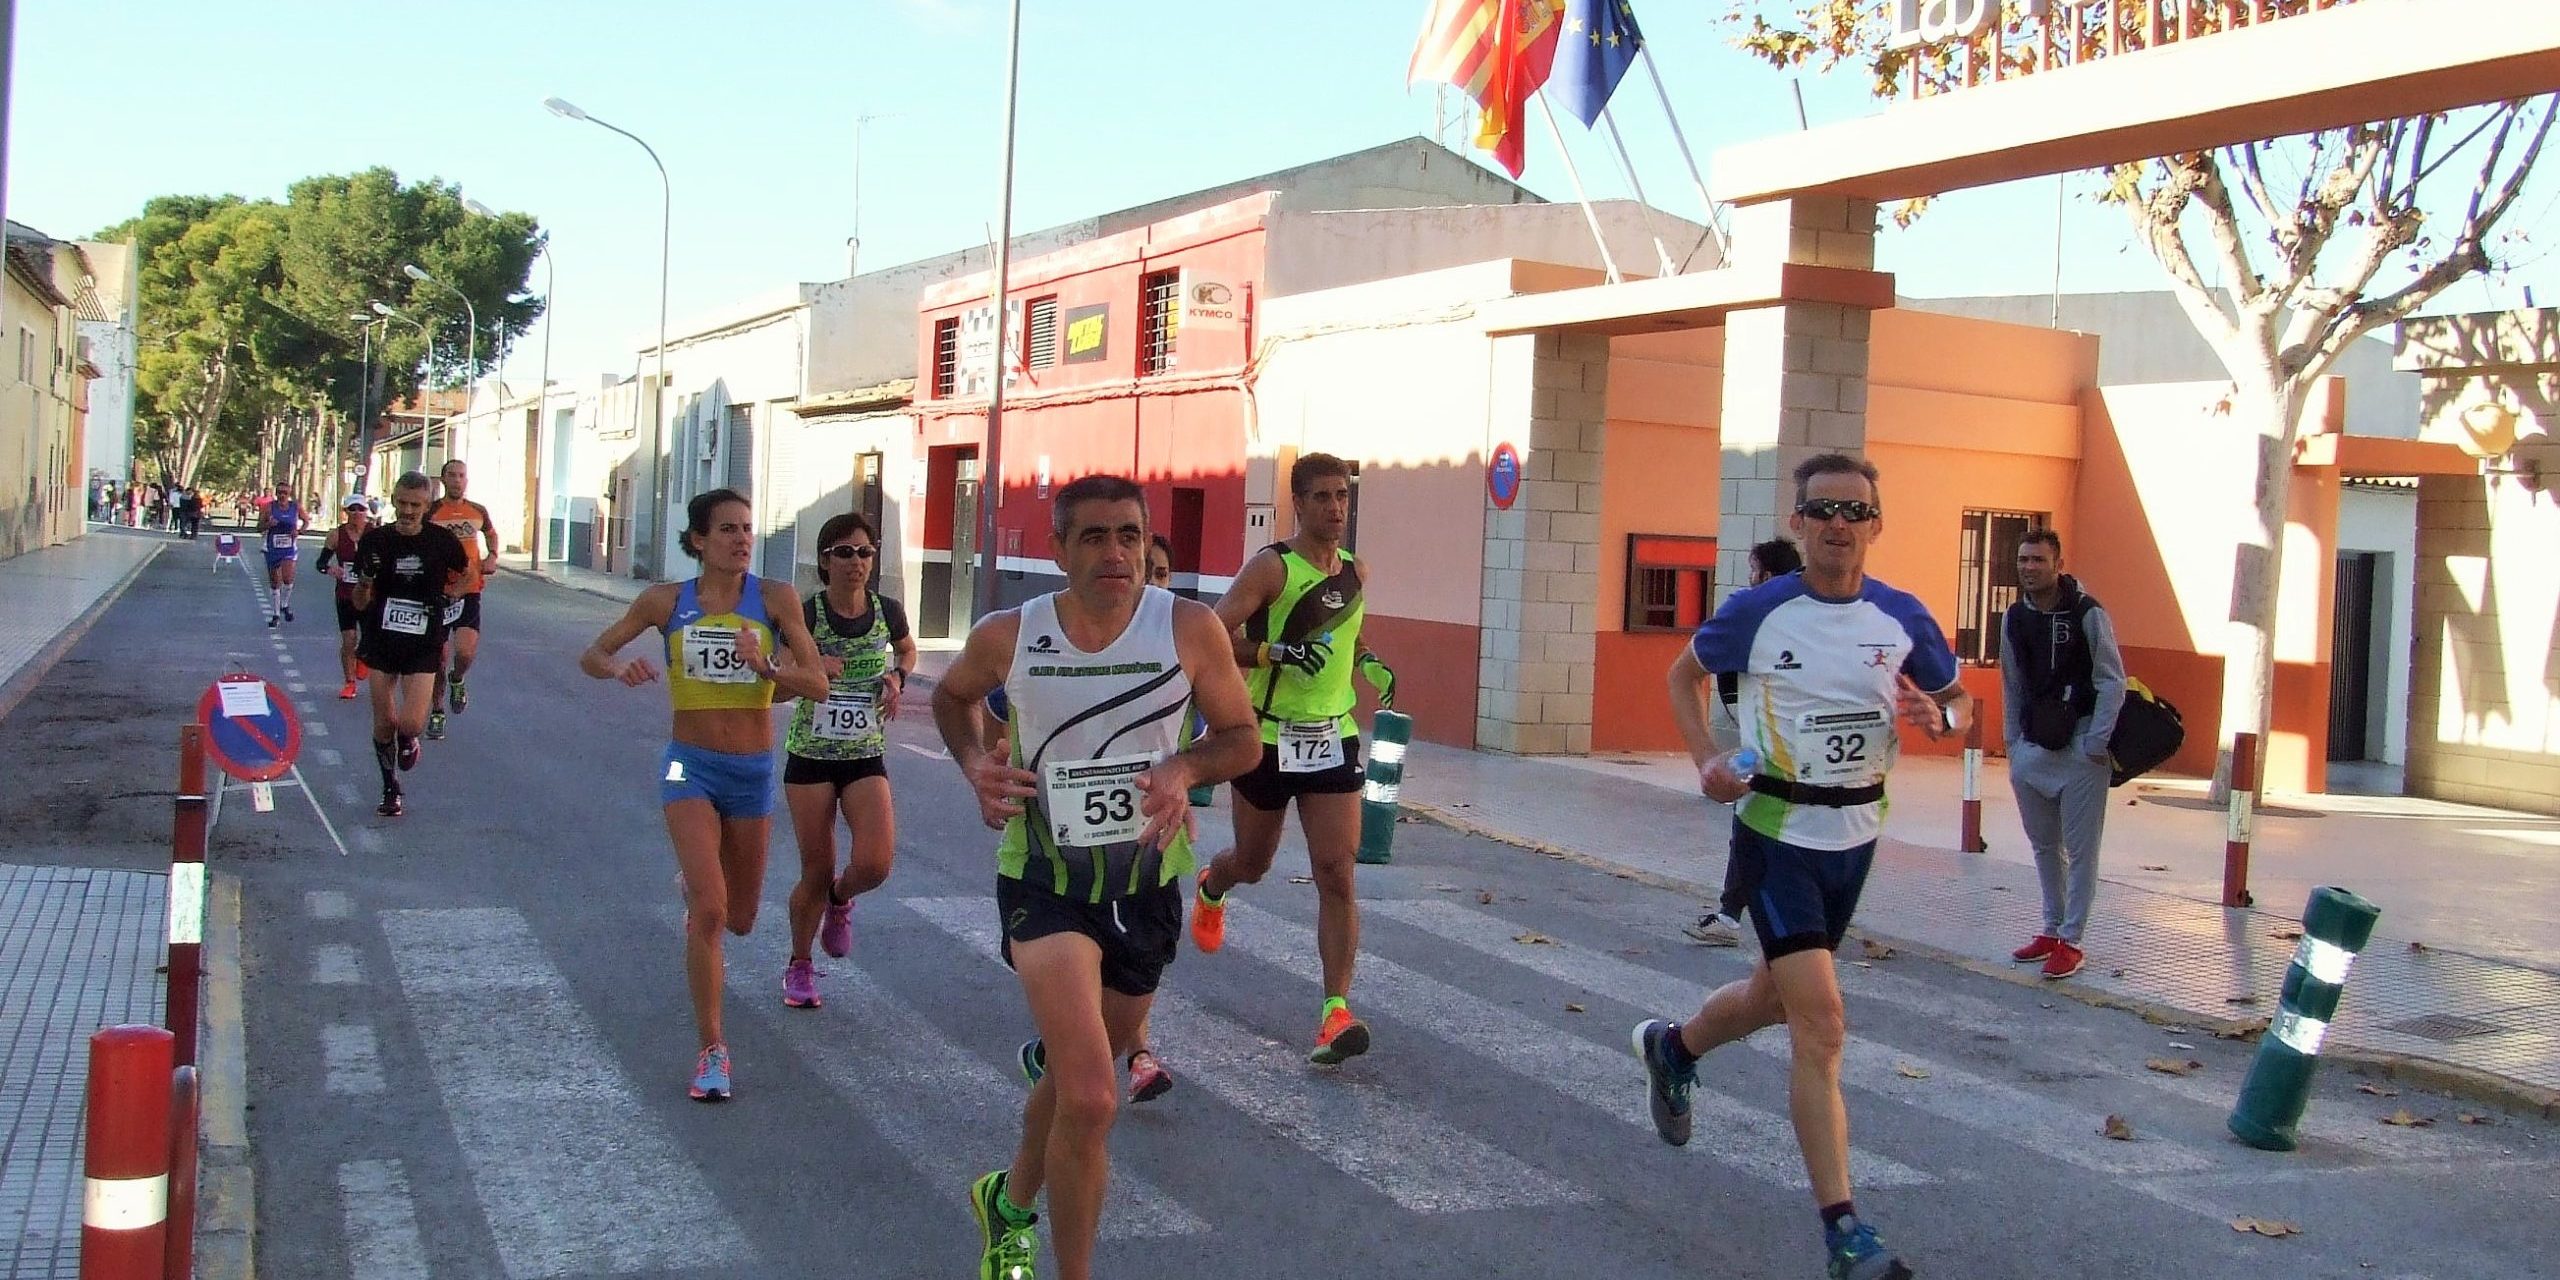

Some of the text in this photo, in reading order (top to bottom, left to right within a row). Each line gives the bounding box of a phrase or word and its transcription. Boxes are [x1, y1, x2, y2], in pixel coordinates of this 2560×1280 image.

[1189, 308, 1233, 319] KYMCO
[390, 610, 420, 625] 1054
[698, 648, 746, 670] 139
[828, 709, 868, 729] 193
[1291, 740, 1332, 760] 172
[1826, 733, 1865, 764] 32
[1084, 788, 1134, 825] 53
